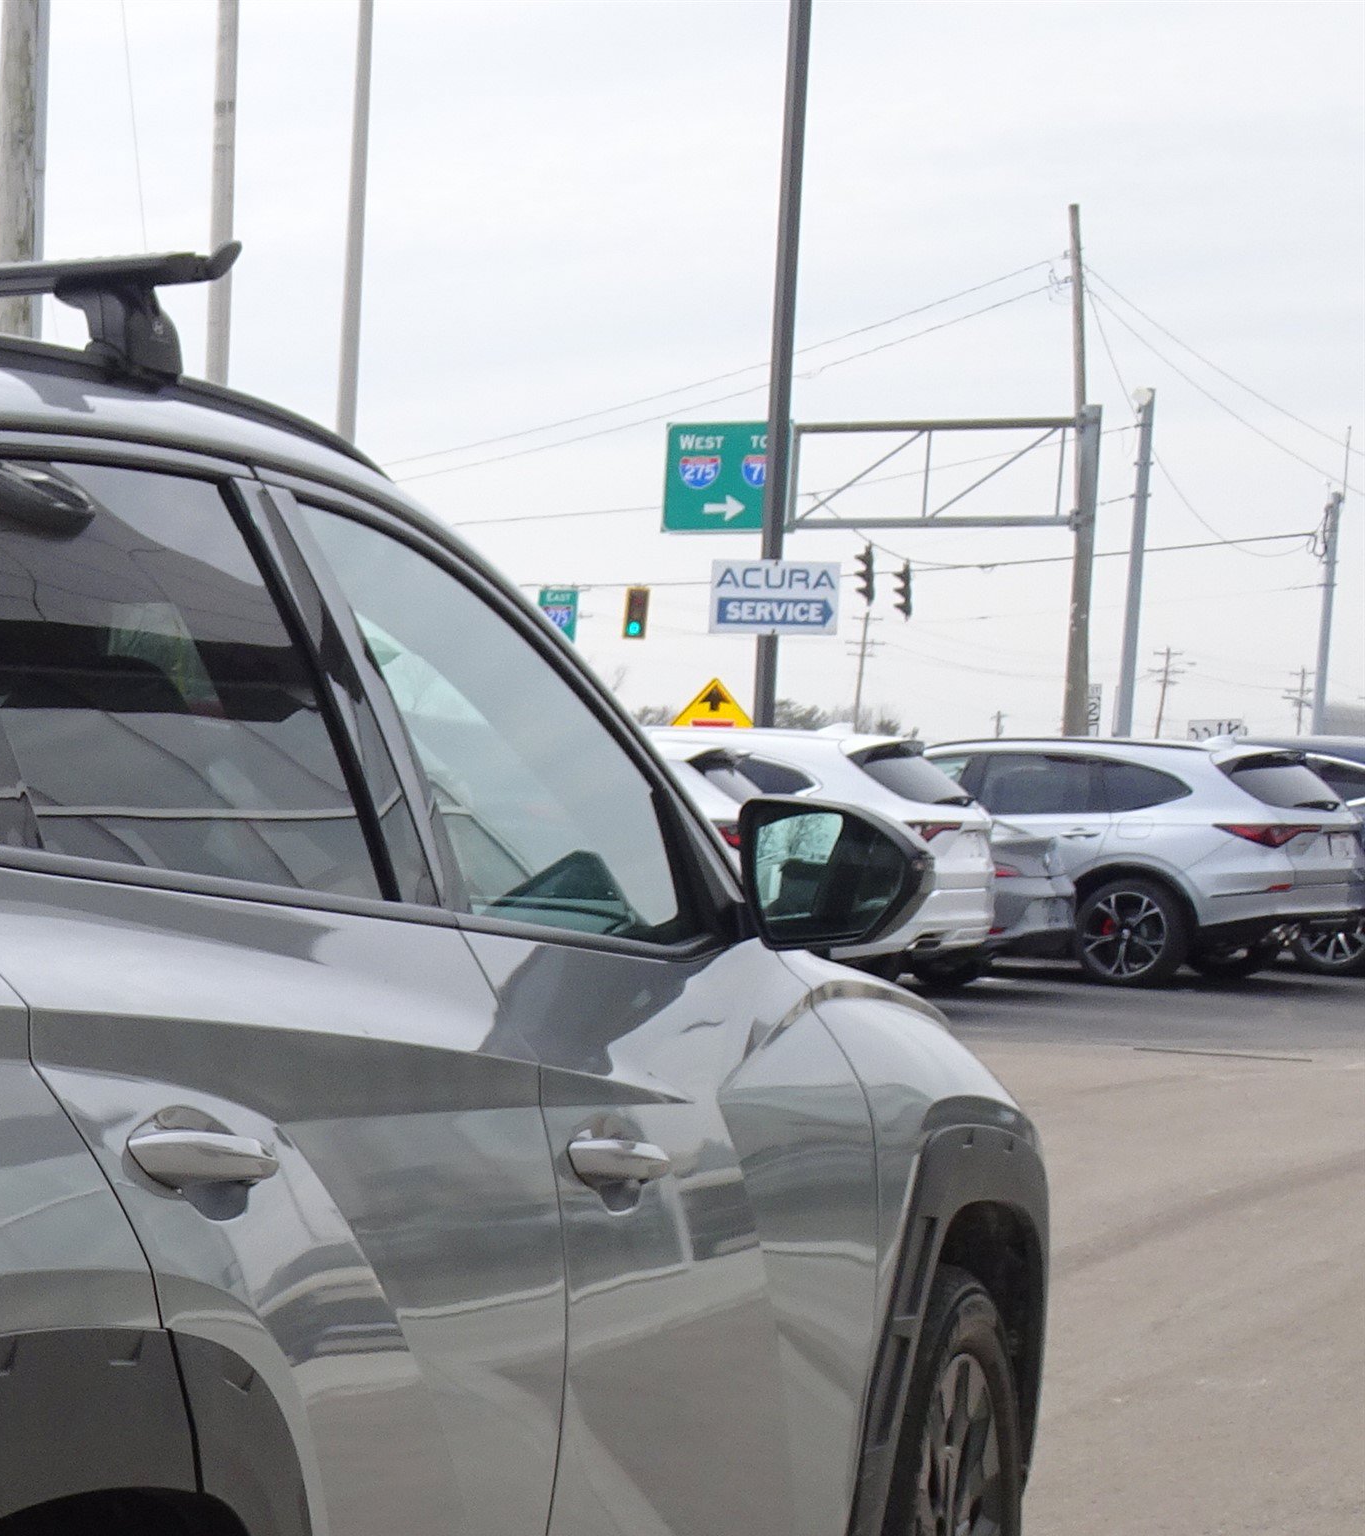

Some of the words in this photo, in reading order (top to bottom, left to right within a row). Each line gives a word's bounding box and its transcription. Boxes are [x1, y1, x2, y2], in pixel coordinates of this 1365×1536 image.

[679, 434, 724, 450] WEST
[683, 463, 716, 480] 275
[716, 567, 835, 589] ACURA
[726, 601, 823, 621] SERVICE
